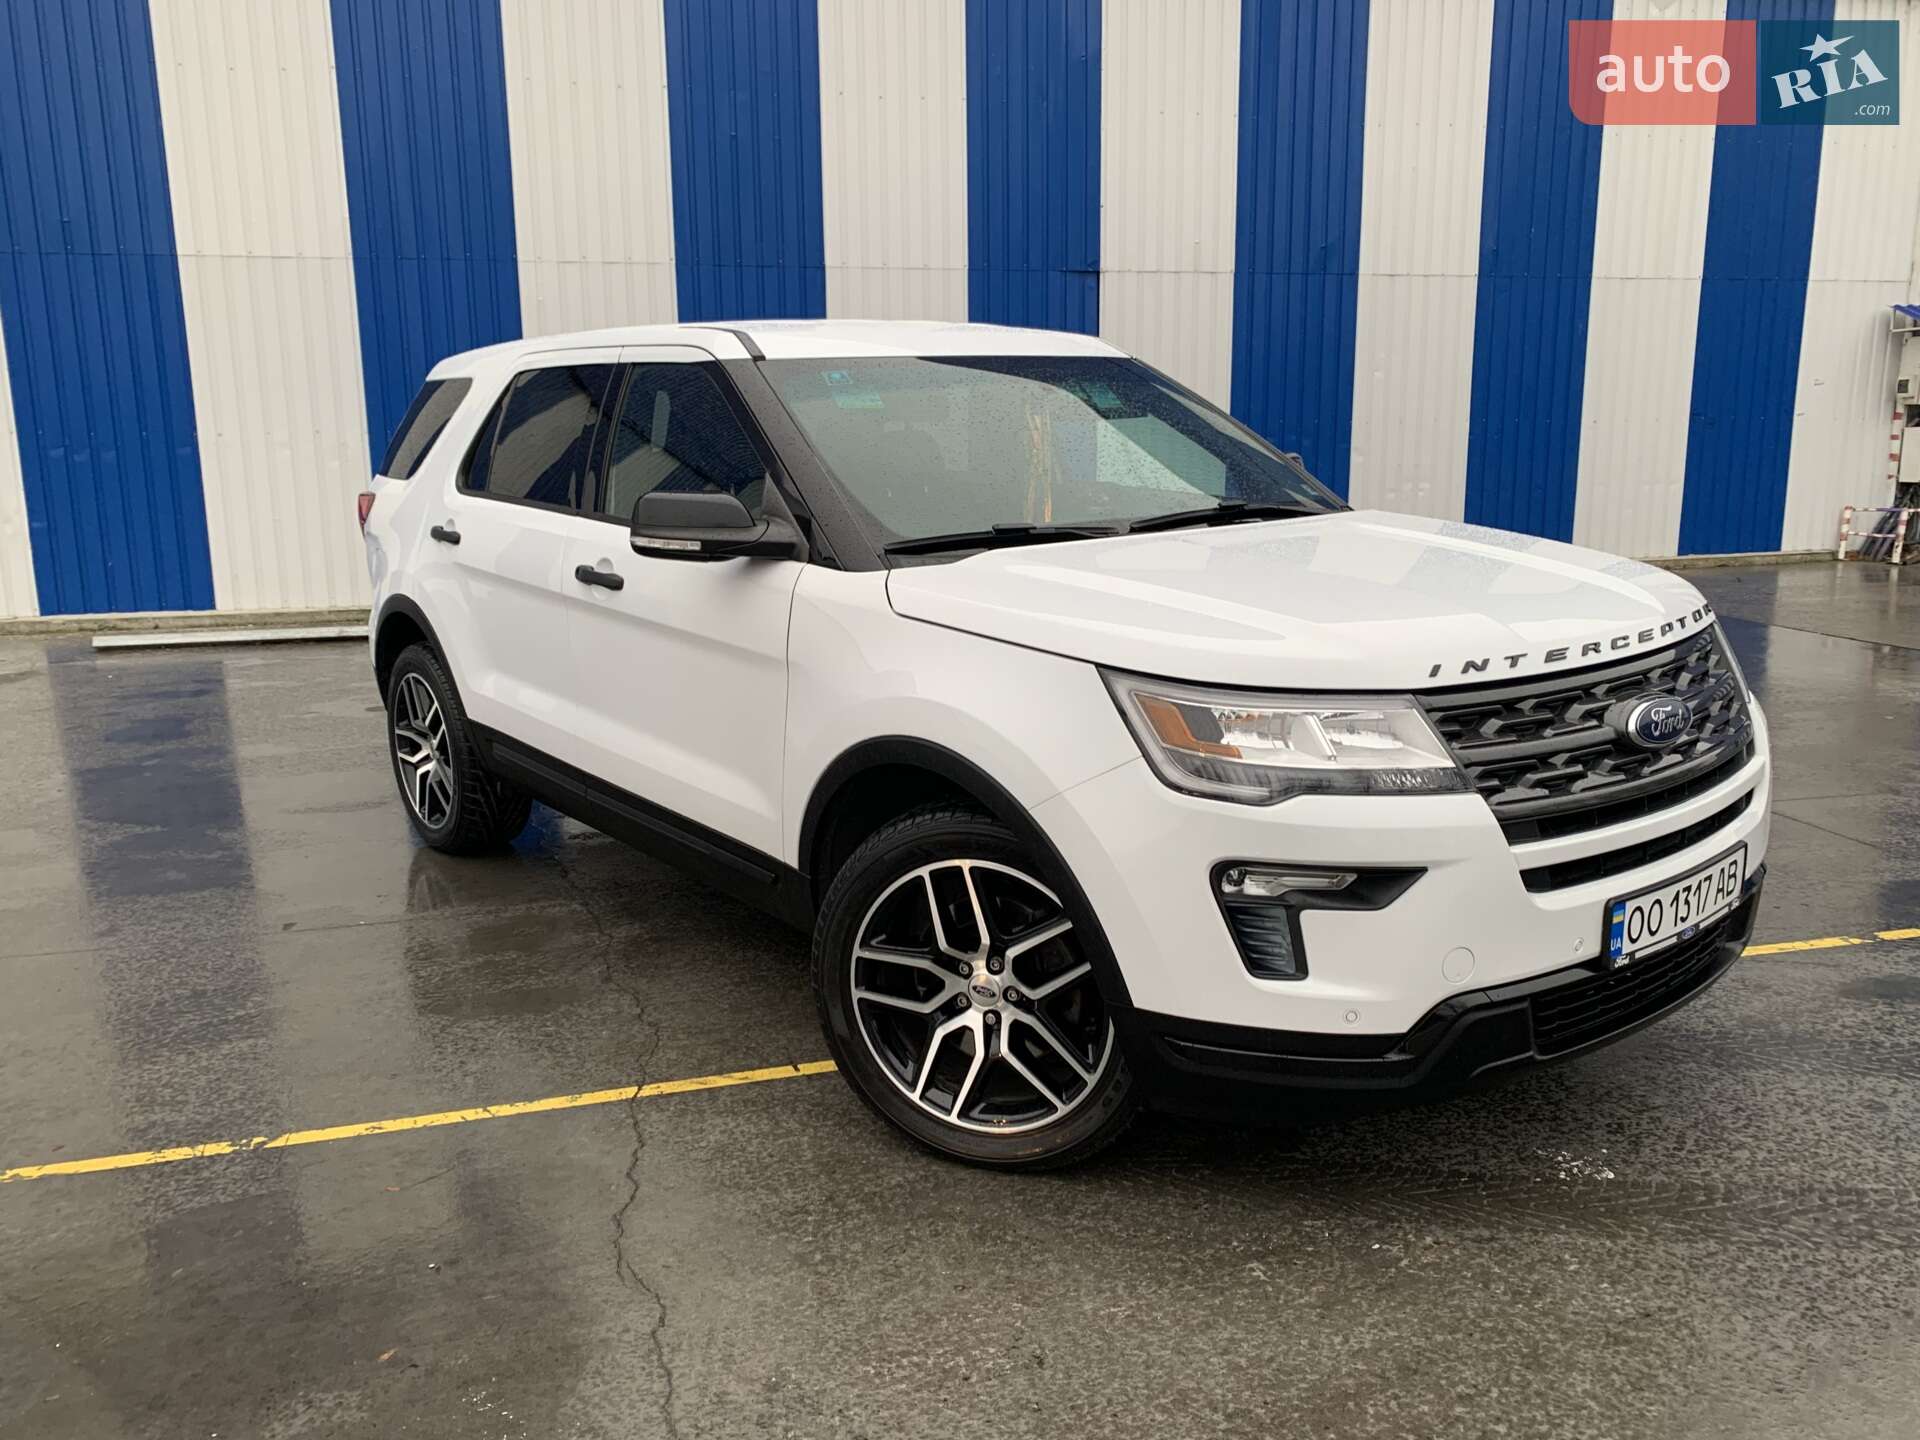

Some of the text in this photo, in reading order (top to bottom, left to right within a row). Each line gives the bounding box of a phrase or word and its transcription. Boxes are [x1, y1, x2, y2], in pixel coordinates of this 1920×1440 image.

[1651, 705, 1684, 737] Ford
[1628, 860, 1738, 944] OO 1317 AB
[1610, 936, 1622, 951] UA
